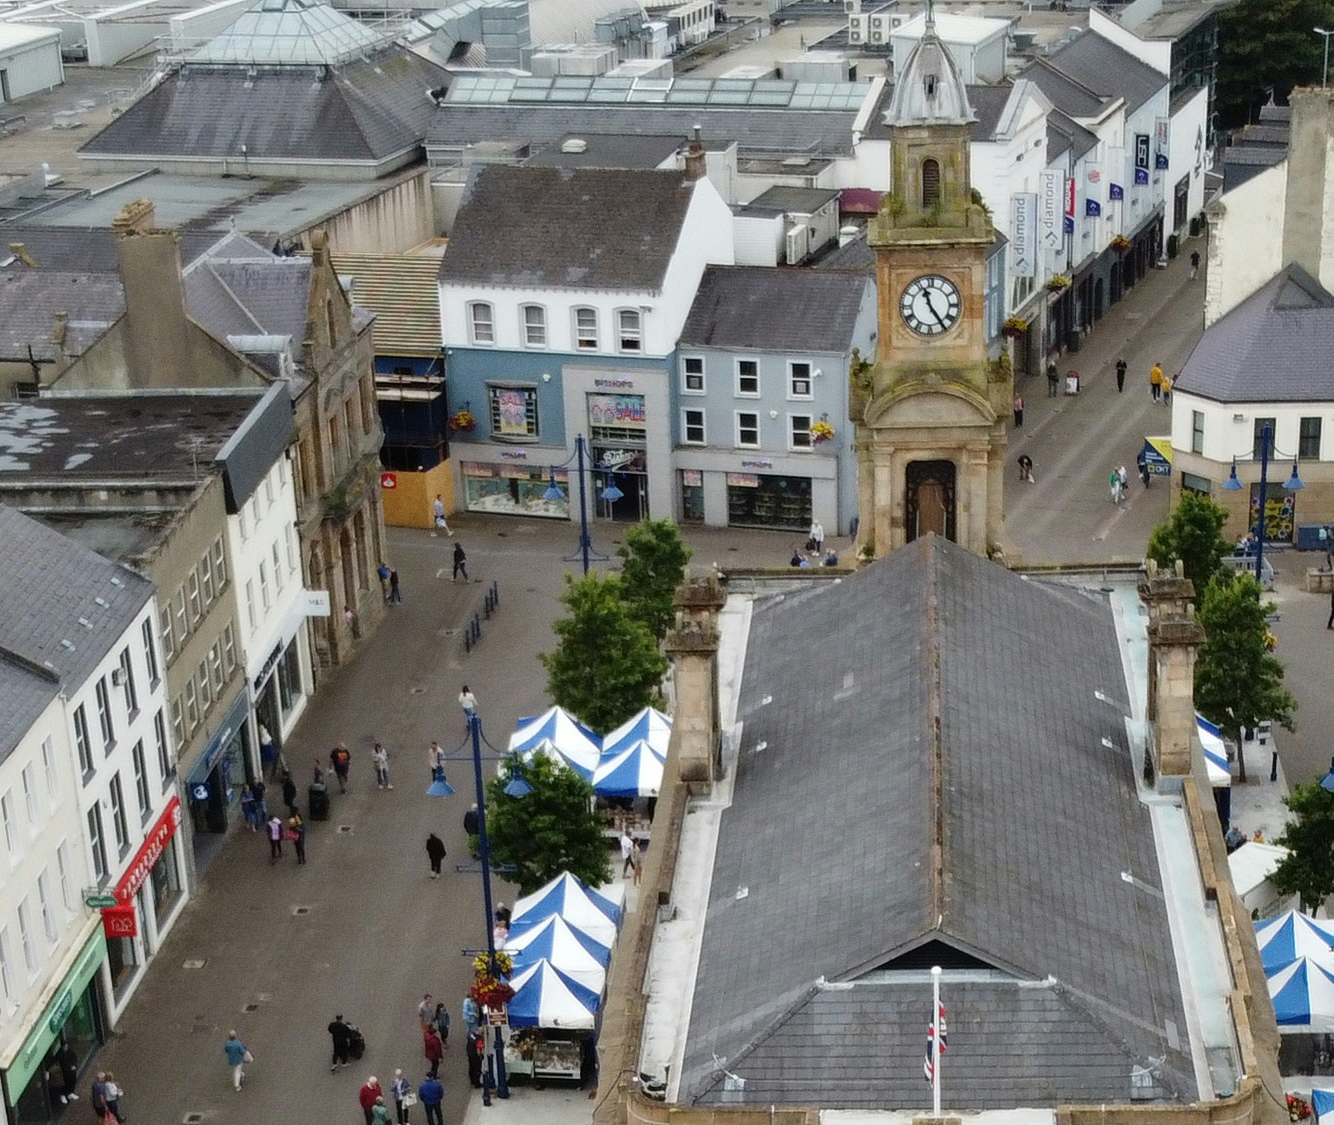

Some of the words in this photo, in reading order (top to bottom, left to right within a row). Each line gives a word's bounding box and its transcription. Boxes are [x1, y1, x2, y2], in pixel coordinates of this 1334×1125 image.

[1138, 136, 1148, 166] USC
[1043, 173, 1055, 229] diamond
[1015, 198, 1026, 255] diamond
[615, 402, 646, 422] SALE
